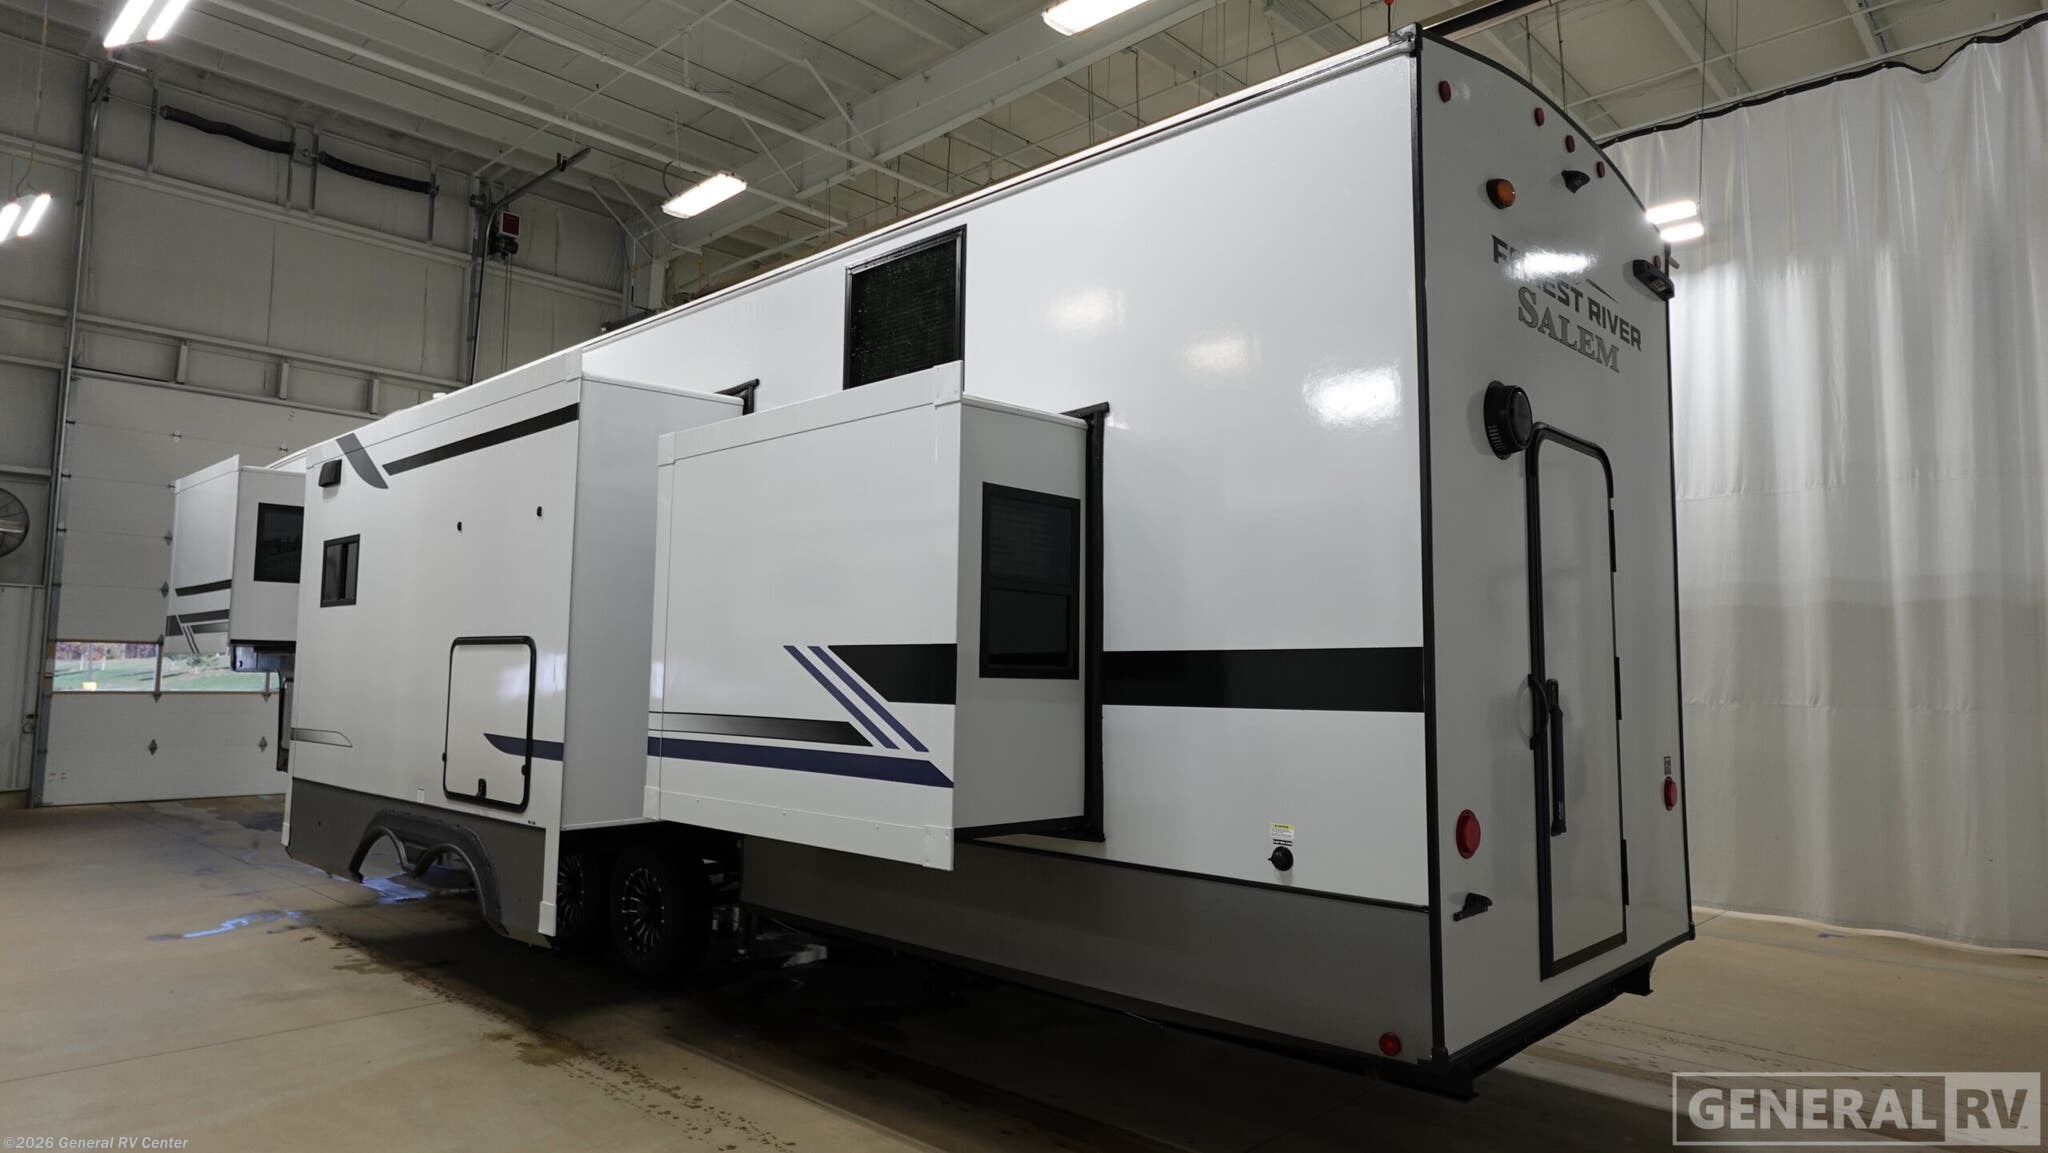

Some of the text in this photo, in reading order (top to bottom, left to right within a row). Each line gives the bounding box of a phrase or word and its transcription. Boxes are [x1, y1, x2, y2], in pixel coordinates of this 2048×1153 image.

[1492, 234, 1643, 351] FEST RIVER
[1518, 286, 1621, 374] SALEM
